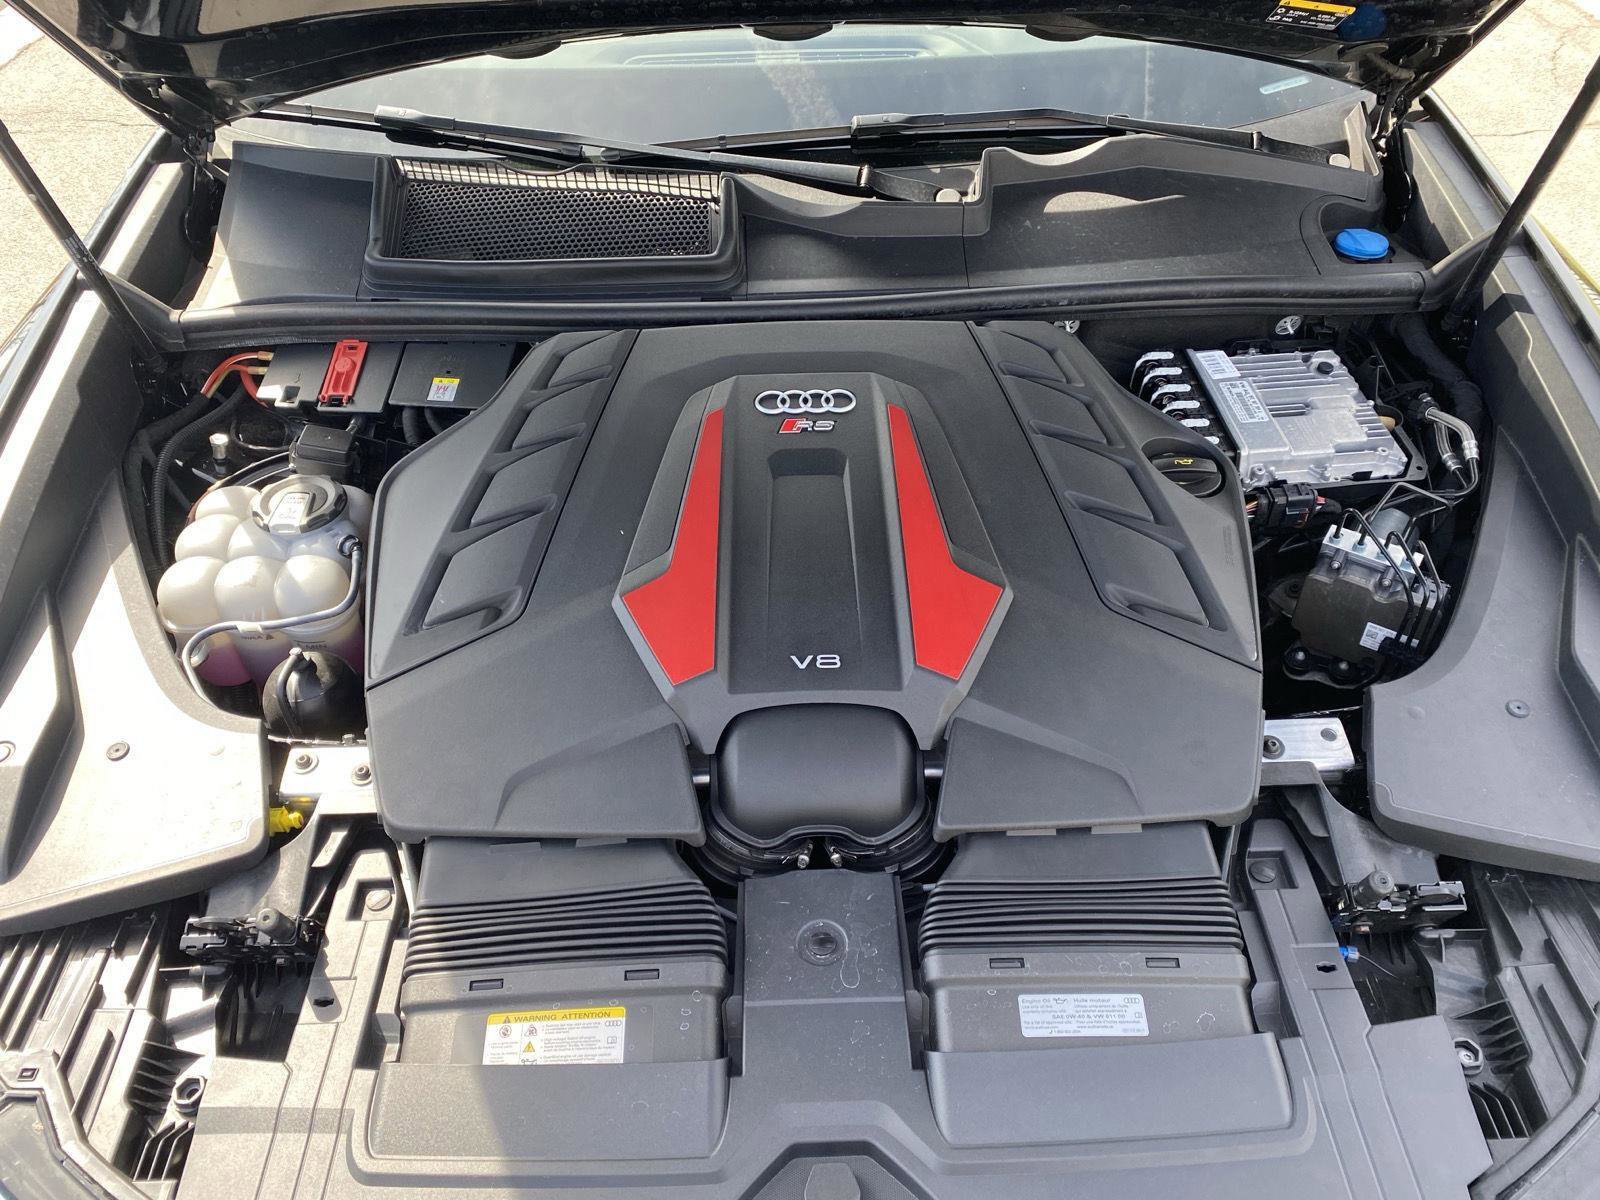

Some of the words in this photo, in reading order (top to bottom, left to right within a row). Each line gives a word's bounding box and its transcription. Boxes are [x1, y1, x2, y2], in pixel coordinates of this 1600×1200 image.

[779, 418, 835, 433] RS
[790, 654, 841, 669] V8
[514, 1014, 557, 1023] WARNING
[562, 1011, 611, 1021] ATTENTION
